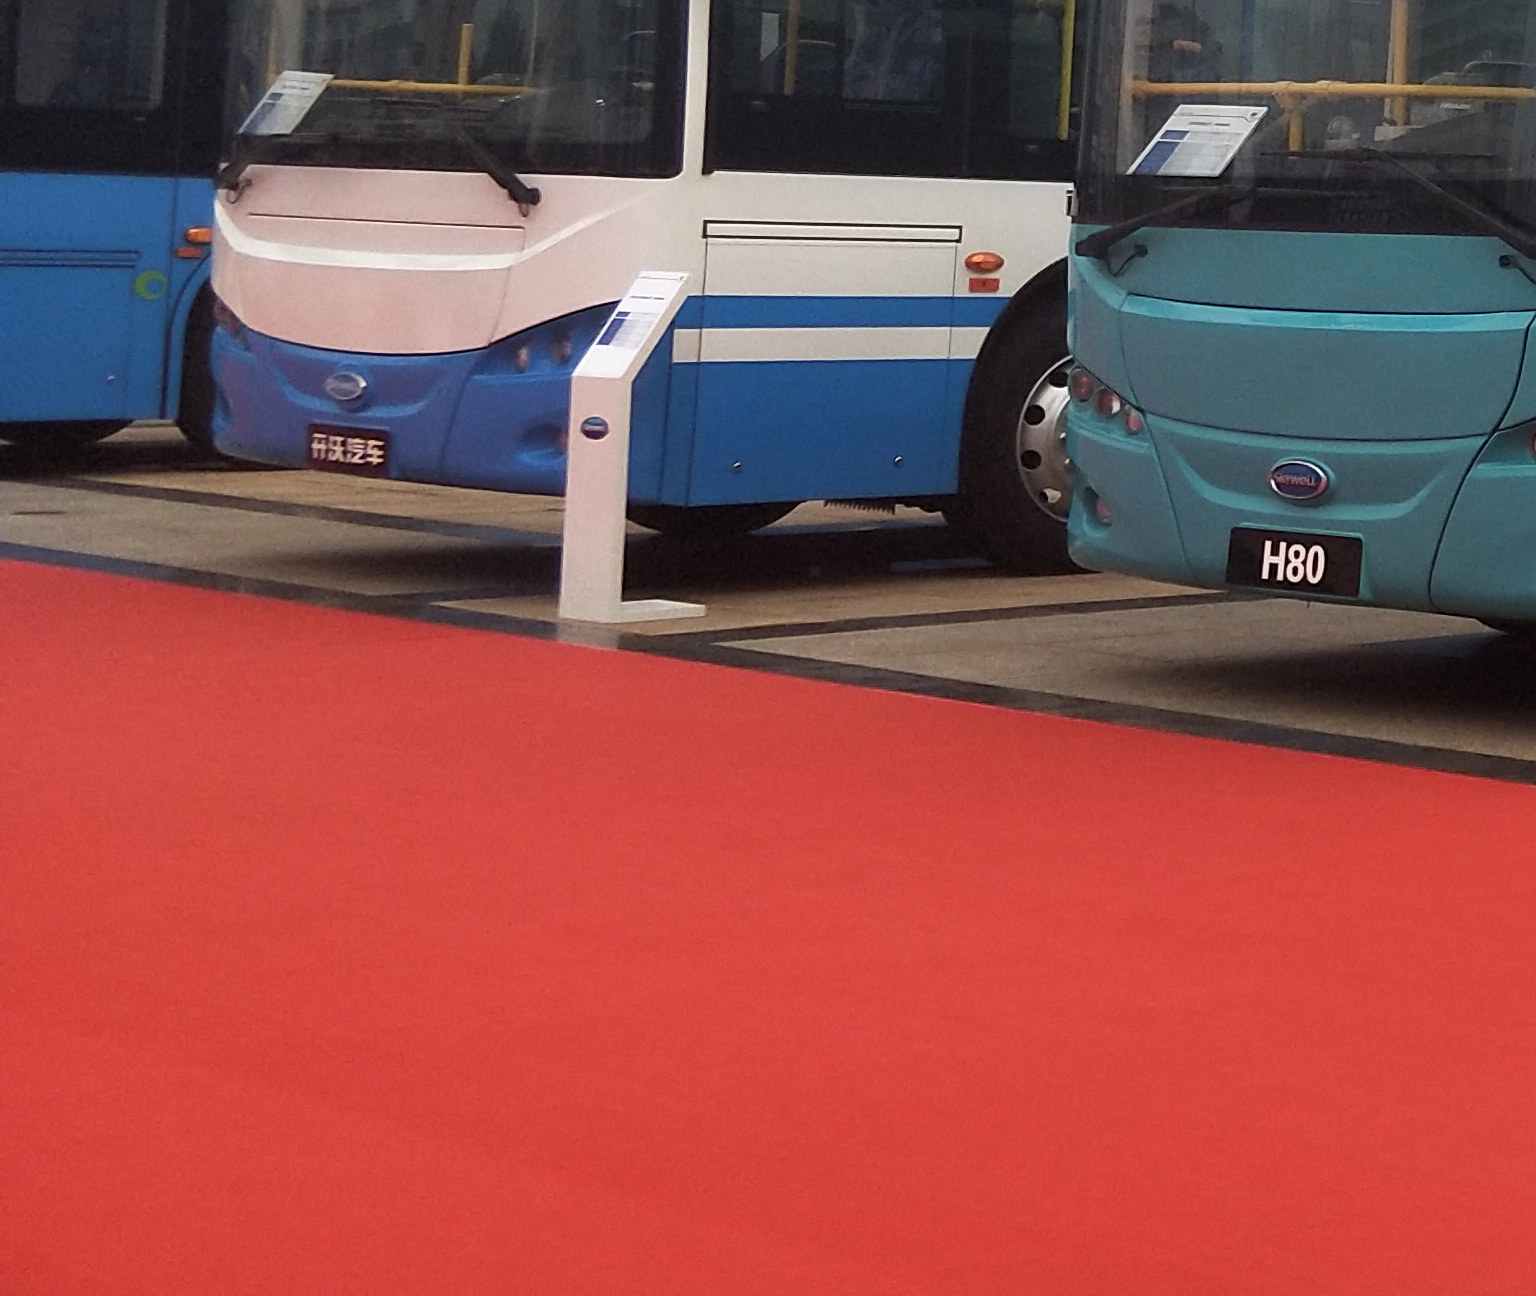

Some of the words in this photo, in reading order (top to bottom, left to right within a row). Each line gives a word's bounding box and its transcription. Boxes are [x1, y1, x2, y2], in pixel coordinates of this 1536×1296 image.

[311, 433, 385, 465] 开沃汽车
[1261, 539, 1326, 585] H80
